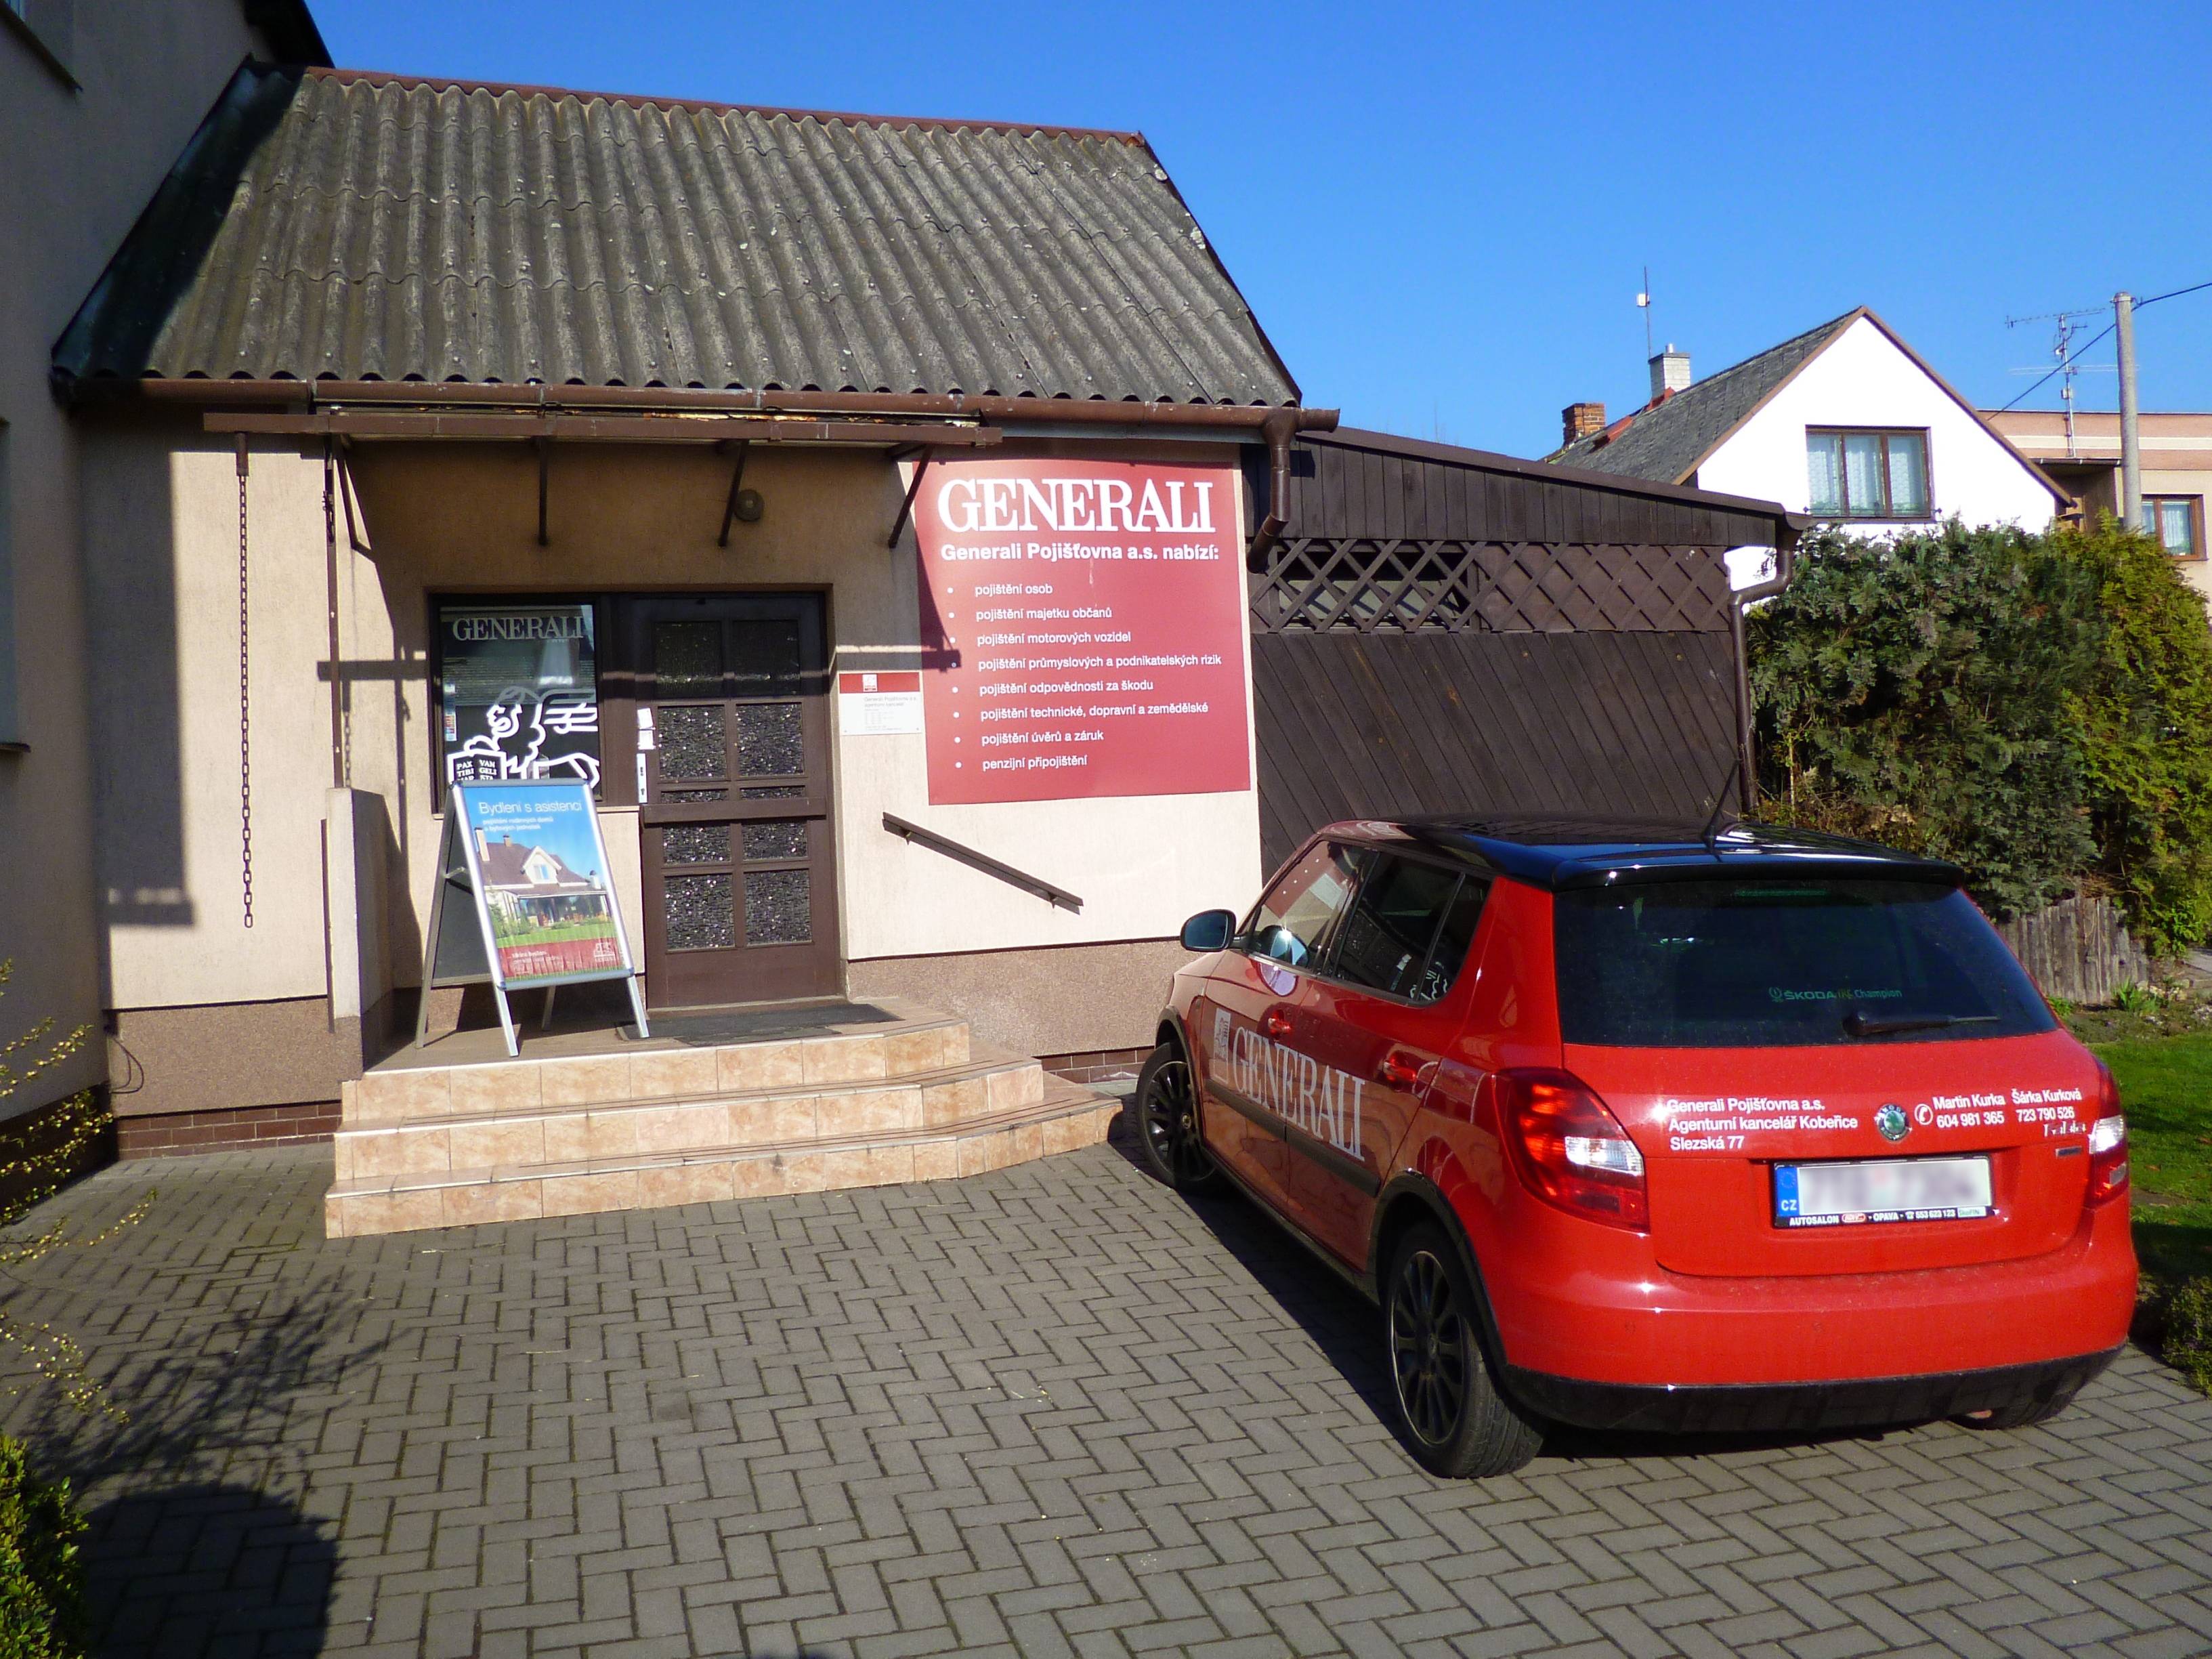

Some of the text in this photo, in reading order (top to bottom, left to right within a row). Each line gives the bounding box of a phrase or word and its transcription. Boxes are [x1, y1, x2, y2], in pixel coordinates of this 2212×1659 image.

[938, 478, 1216, 532] GENERALI
[941, 542, 1219, 562] Generali Pojišťovna a.s. nabízí:
[975, 583, 1053, 597] pojištění osob
[976, 607, 1112, 622] pojištění majetku občanů
[452, 616, 583, 641] GENERALI
[977, 631, 1131, 647] pojištění motorových vozidel
[979, 654, 1222, 671] pojištění průmyslových a podnikatelských rizik
[979, 679, 1153, 696] pojištění odpovědnosti za škodu
[981, 702, 1208, 721] pojištění technické, dopravní a zemědělské
[982, 730, 1104, 746] pojištění úvěrů a záruk
[456, 761, 473, 770] PAX
[479, 759, 495, 768] VAN
[983, 755, 1088, 772] penzijní připojištění
[456, 768, 474, 777] TIBI
[525, 804, 532, 813] s
[1854, 988, 1902, 999] Champion
[1233, 1026, 1365, 1162] GENERALI
[1932, 1093, 2005, 1110] Martin Kurka
[2011, 1087, 2082, 1104] Šárka Kurková
[1667, 1097, 1825, 1114] Generali Pojišťovna a.s.
[1936, 1111, 2005, 1128] 604 981 365
[2016, 1106, 2075, 1122] 723 790 526
[1669, 1114, 1858, 1134] Agenturní kancelář Kobeřice
[1670, 1135, 1745, 1151] Slezská 77
[1781, 1200, 1798, 1211] CZ
[1789, 1215, 1839, 1226] AUTOSALON
[1873, 1211, 1898, 1221] OPAVA
